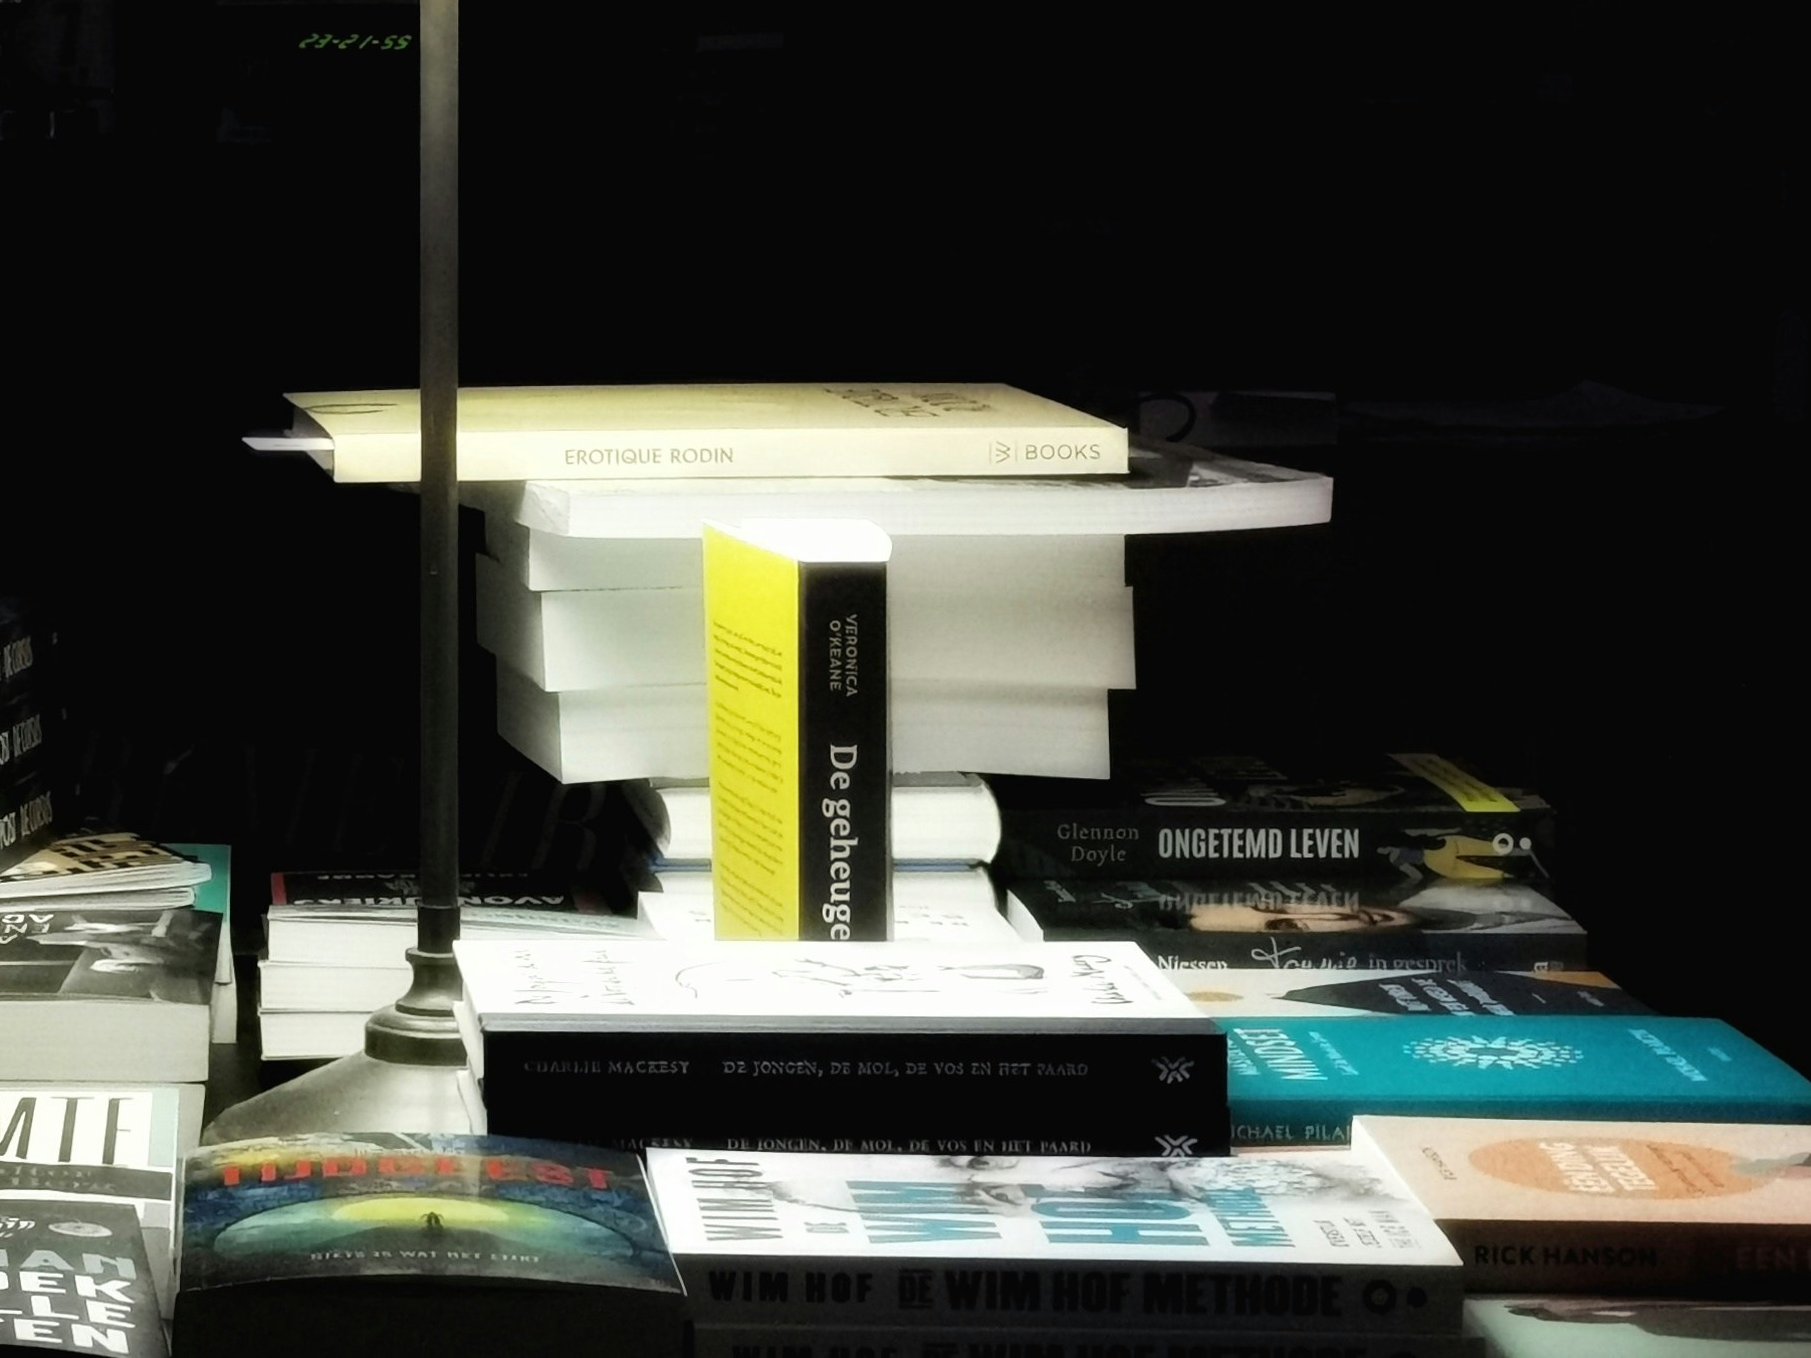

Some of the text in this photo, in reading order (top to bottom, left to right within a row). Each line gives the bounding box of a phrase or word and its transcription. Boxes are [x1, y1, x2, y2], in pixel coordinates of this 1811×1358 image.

[563, 445, 735, 467] EROTIQUE RODIN
[1023, 442, 1102, 461] BOOKS
[829, 620, 842, 692] O'KEANE
[845, 613, 859, 698] VERONICA
[821, 744, 859, 940] De geheuge
[1057, 822, 1360, 860] Glennon ONGETEMD LEVEN
[1070, 845, 1127, 866] Doyle
[524, 1060, 601, 1073] CHARLIE
[608, 1060, 690, 1074] MACKESY
[723, 1061, 746, 1073] DE
[830, 1062, 851, 1074] DE
[906, 1062, 928, 1074] DE
[934, 1062, 965, 1075] VOS
[971, 1062, 993, 1075] EN
[1233, 1027, 1329, 1081] MINDSET
[937, 1141, 968, 1152] VOS
[1230, 1123, 1295, 1140] ICHAEL
[685, 1157, 784, 1242] WIM HOF
[846, 1180, 1003, 1244] WIM
[1020, 1183, 1211, 1247] HOF
[1473, 1245, 1535, 1265] RICK
[1542, 1245, 1658, 1267] HANSON
[707, 1271, 1342, 1316] WIM HOF DE WIM HOF METHODE
